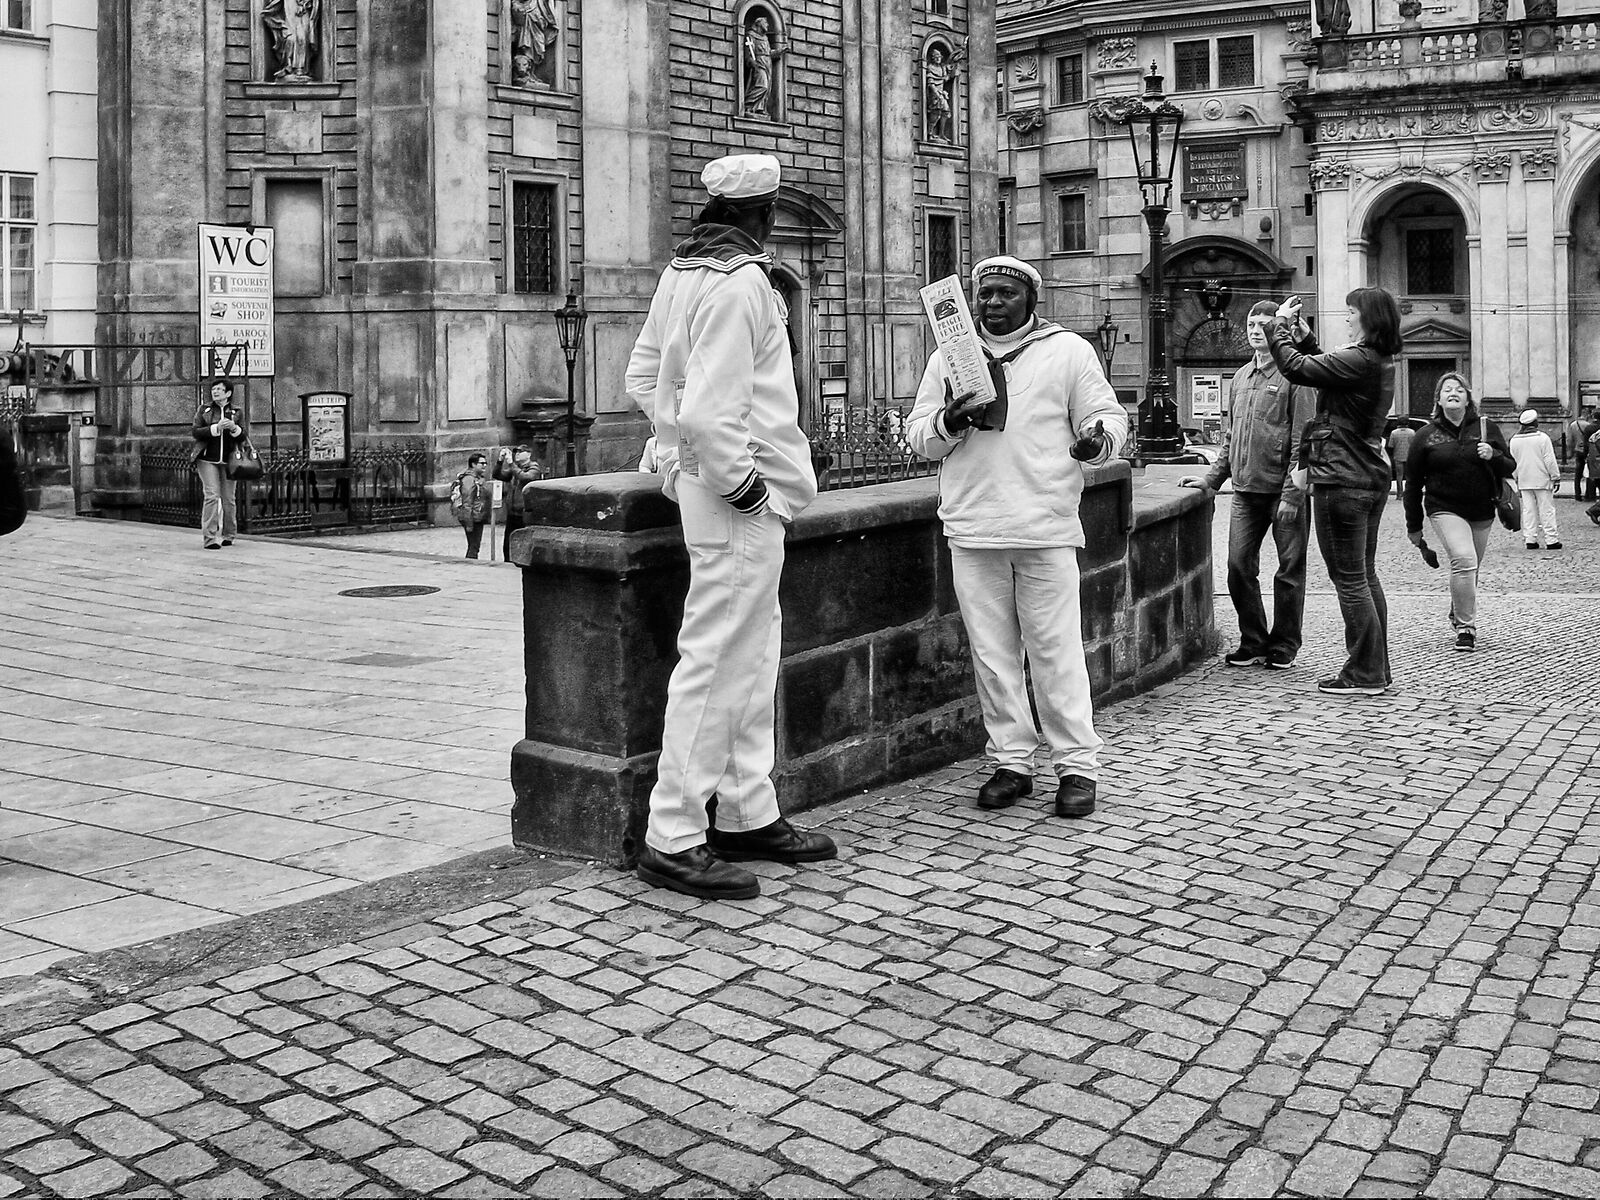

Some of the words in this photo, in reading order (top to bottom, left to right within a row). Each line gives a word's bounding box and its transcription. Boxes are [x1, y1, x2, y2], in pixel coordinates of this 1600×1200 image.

[207, 236, 268, 267] WC
[230, 277, 269, 287] TOURIST
[231, 301, 269, 310] SOUVENIR
[237, 310, 265, 320] SHOP
